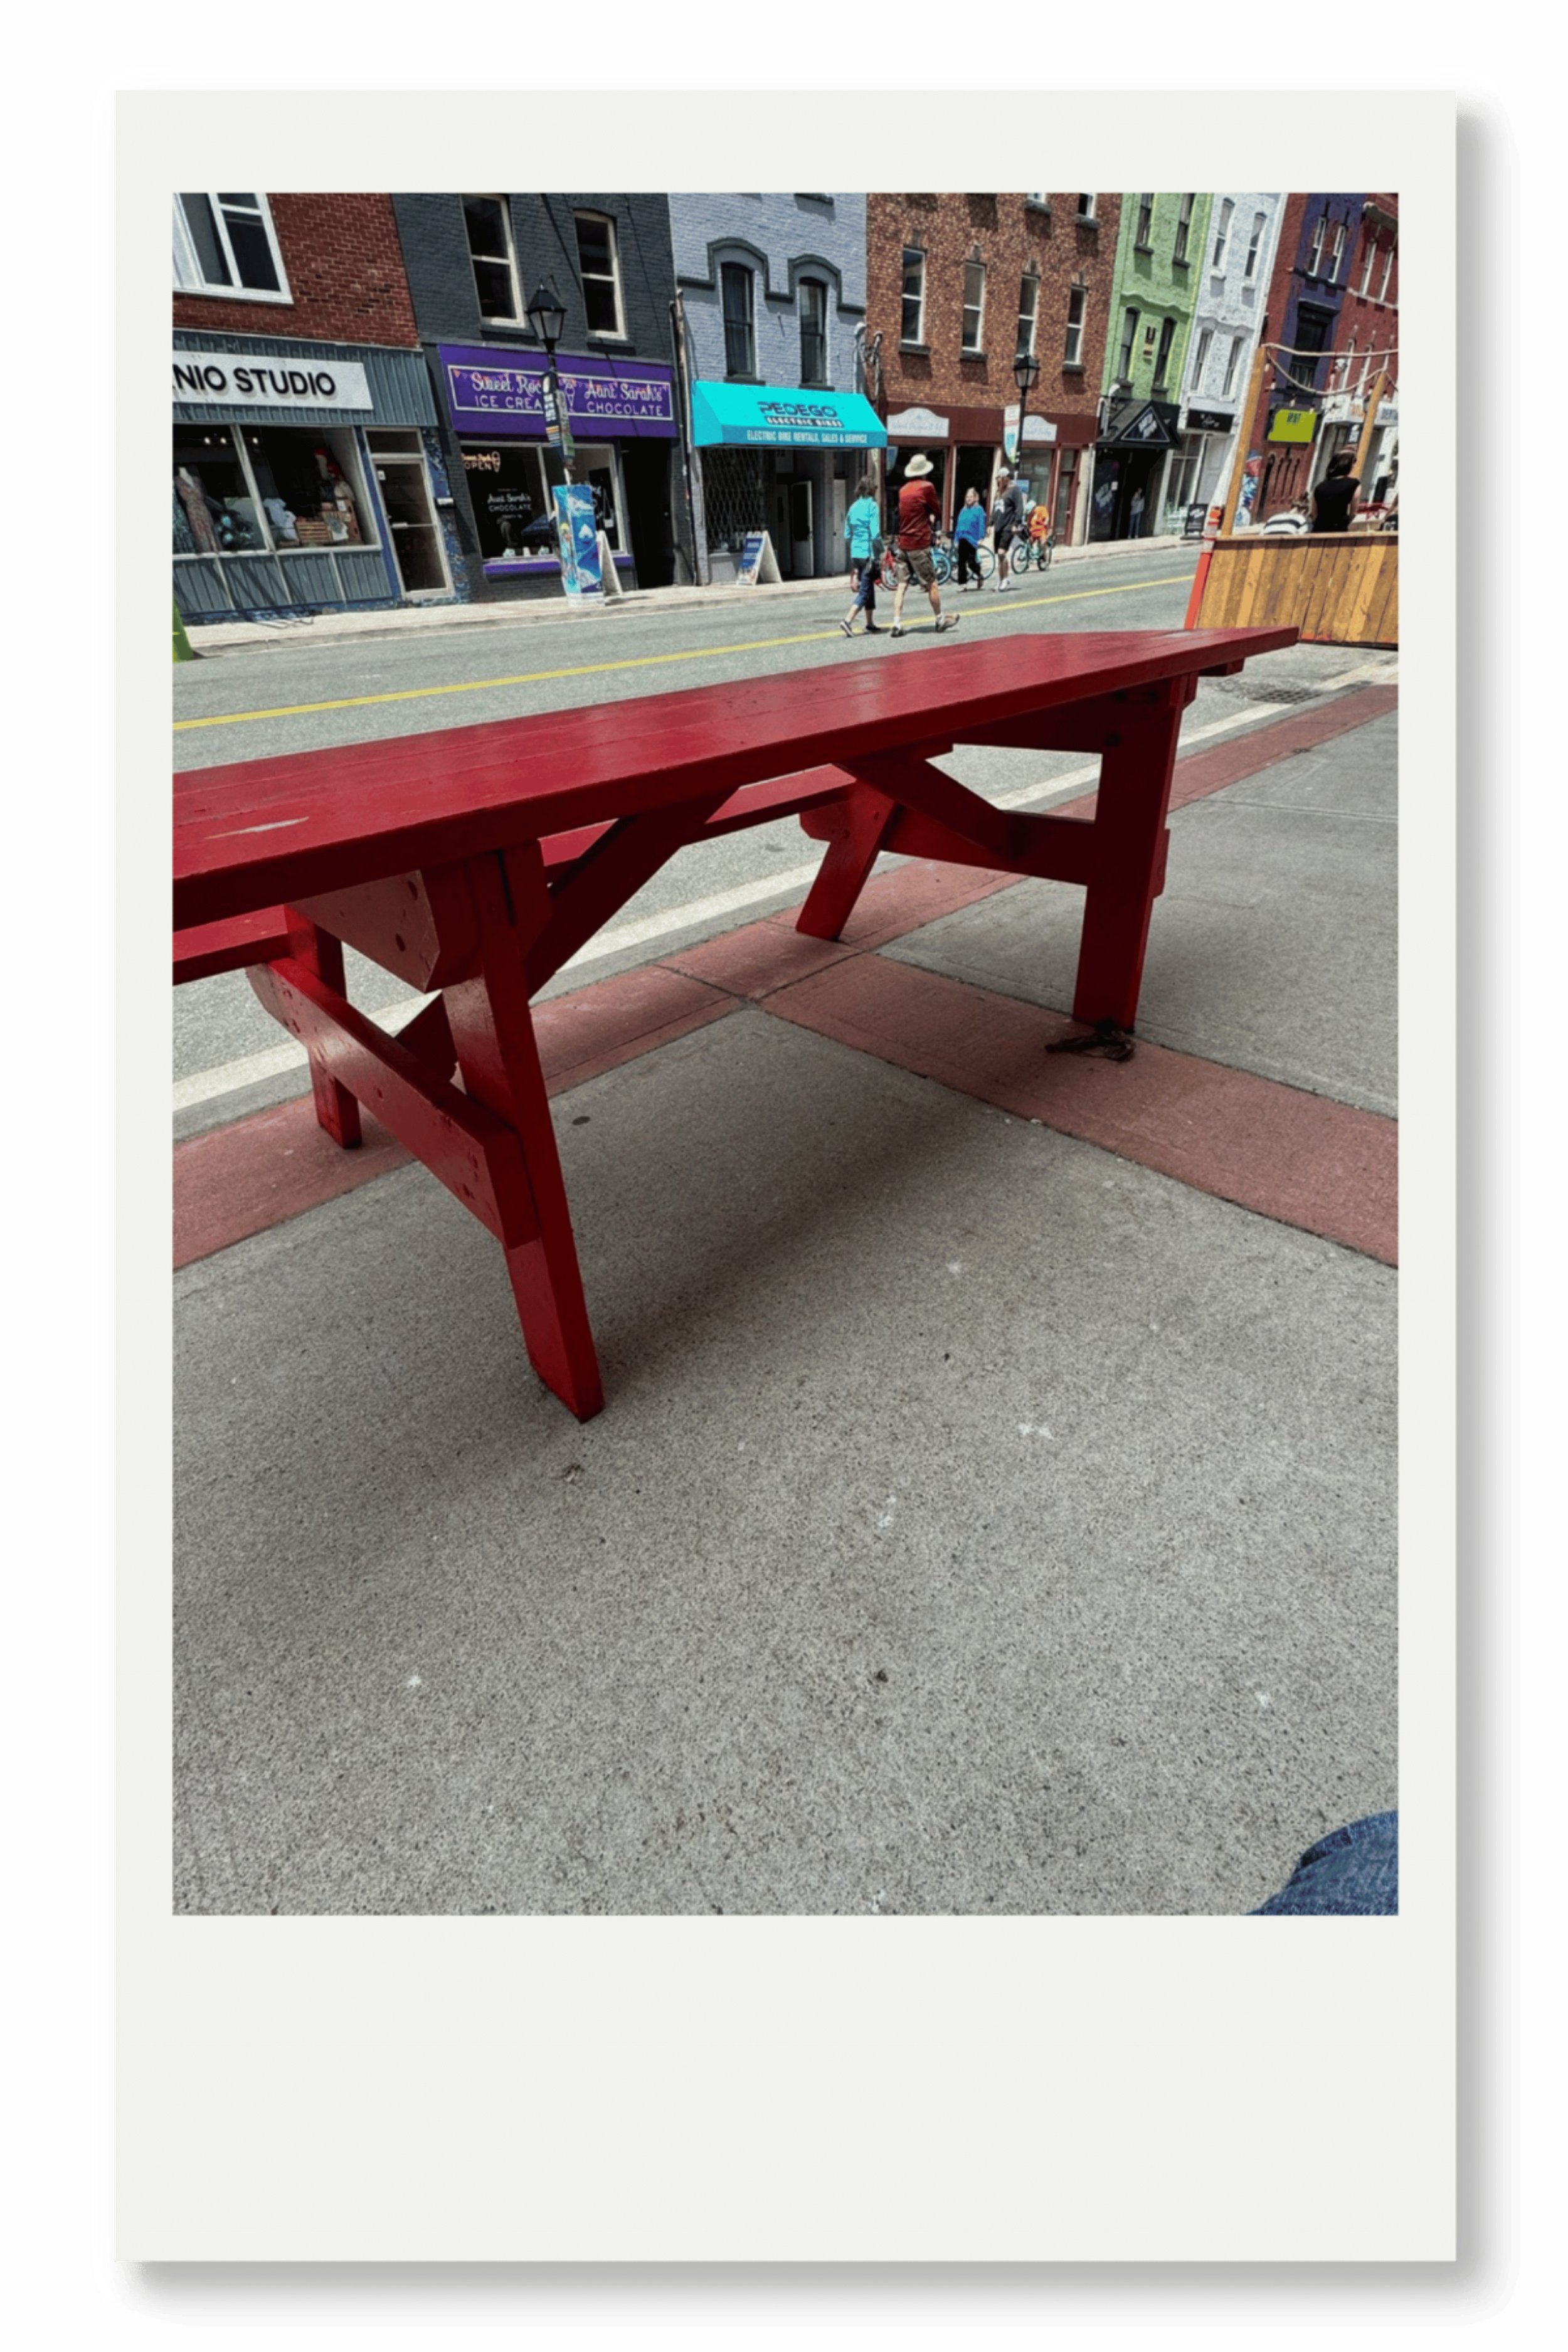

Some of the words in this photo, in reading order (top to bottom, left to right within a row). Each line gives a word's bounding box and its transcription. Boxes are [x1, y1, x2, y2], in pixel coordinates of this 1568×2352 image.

[172, 364, 227, 391] NIO
[233, 367, 336, 396] STUDIO
[471, 371, 514, 393] Sweet
[516, 374, 542, 397] Roc
[584, 379, 617, 400] Aunt
[620, 383, 662, 402] Sarah's
[475, 395, 499, 408] ICE
[505, 396, 543, 410] CREA
[586, 401, 664, 416] CHOCOLATE
[757, 401, 838, 417] PEDEGO
[746, 430, 777, 442] ELECTRIC
[464, 461, 492, 470] OPEN
[488, 504, 532, 512] CHOCOLATE
